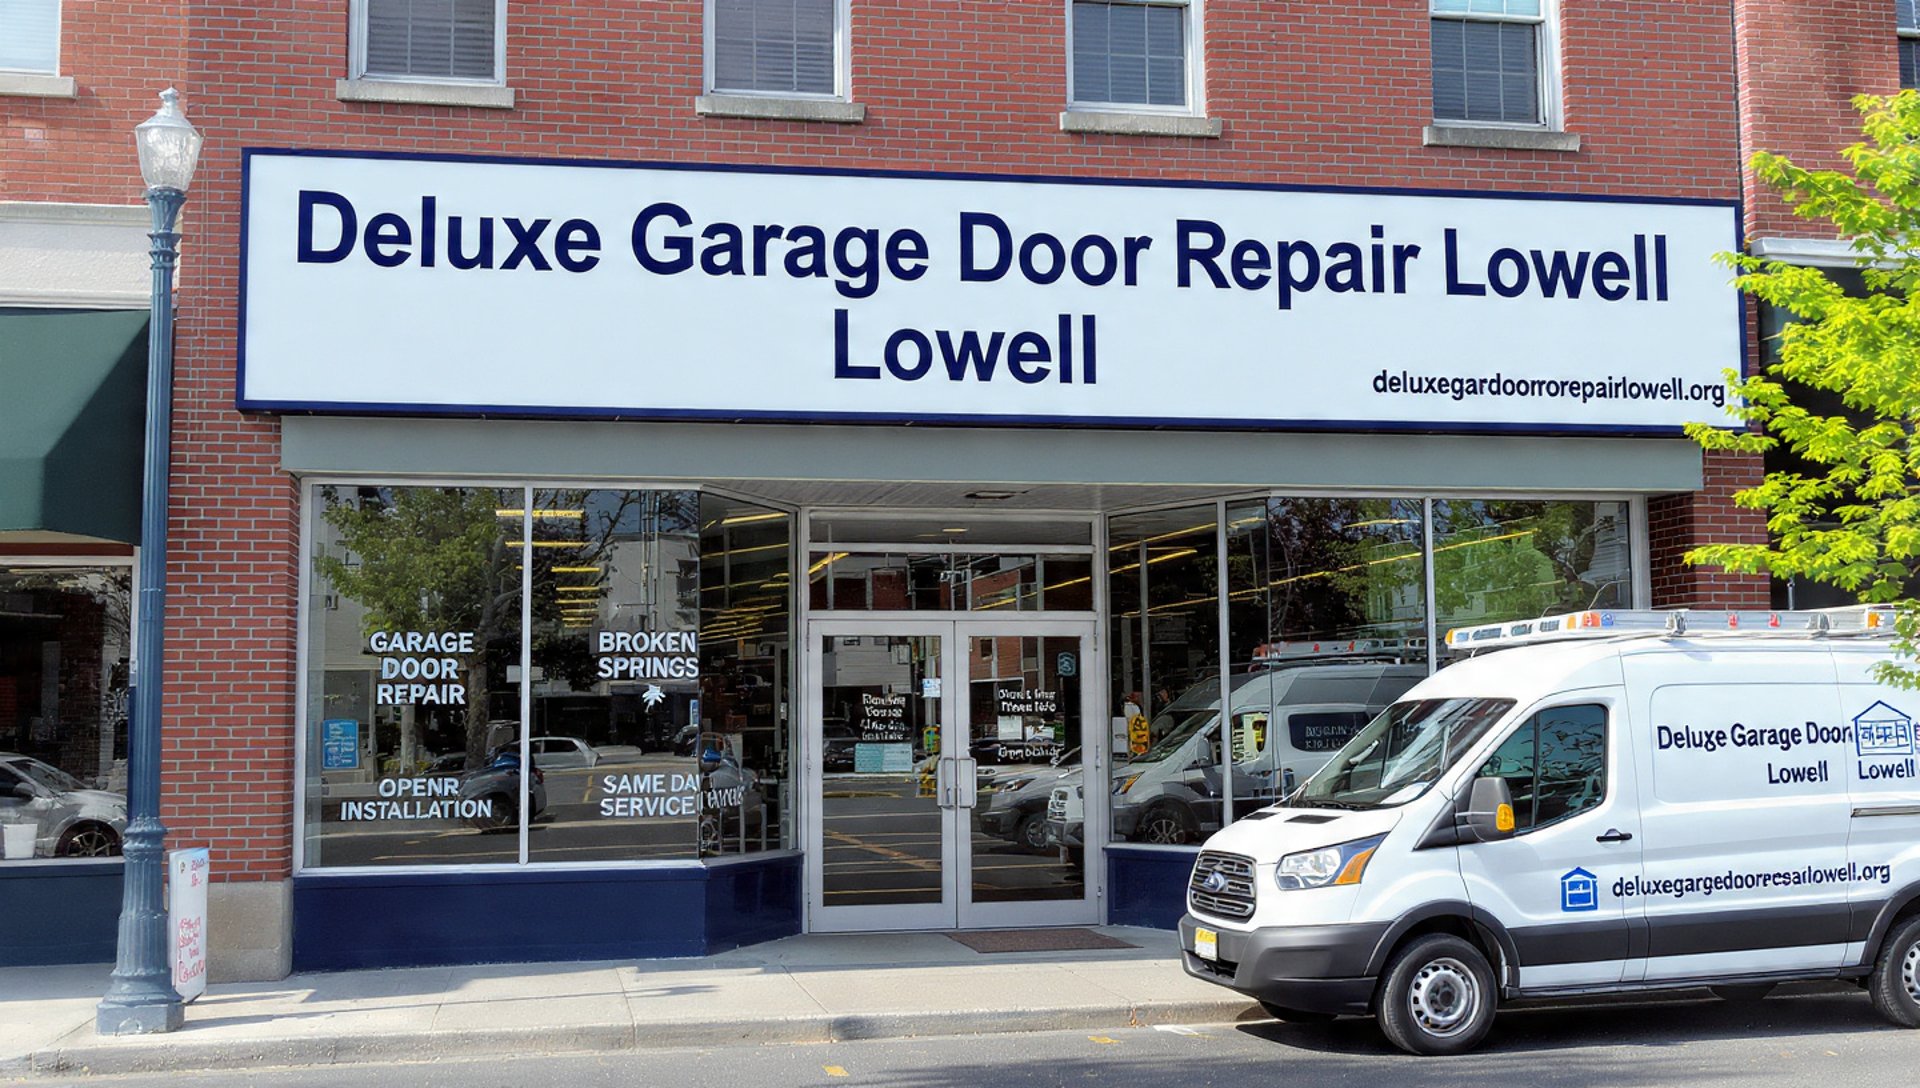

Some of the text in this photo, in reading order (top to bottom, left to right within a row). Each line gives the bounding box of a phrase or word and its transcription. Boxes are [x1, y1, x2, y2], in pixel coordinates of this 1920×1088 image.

[297, 189, 1669, 311] Deluxe Garage Door Repair Lowell
[834, 308, 1097, 386] Lowell
[370, 631, 475, 653] GARAGE
[599, 631, 696, 653] BROKEN
[382, 657, 459, 680] DOOR
[597, 656, 700, 679] SPRINGS
[377, 683, 466, 705] REPAIR
[1730, 722, 1803, 752] Garage
[1767, 759, 1829, 785] Lowell
[1857, 757, 1916, 780] Lowell
[378, 777, 460, 798] OPENR
[602, 773, 667, 795] SAME
[340, 799, 493, 821] INSTALLATION
[599, 795, 697, 817] SERVICE
